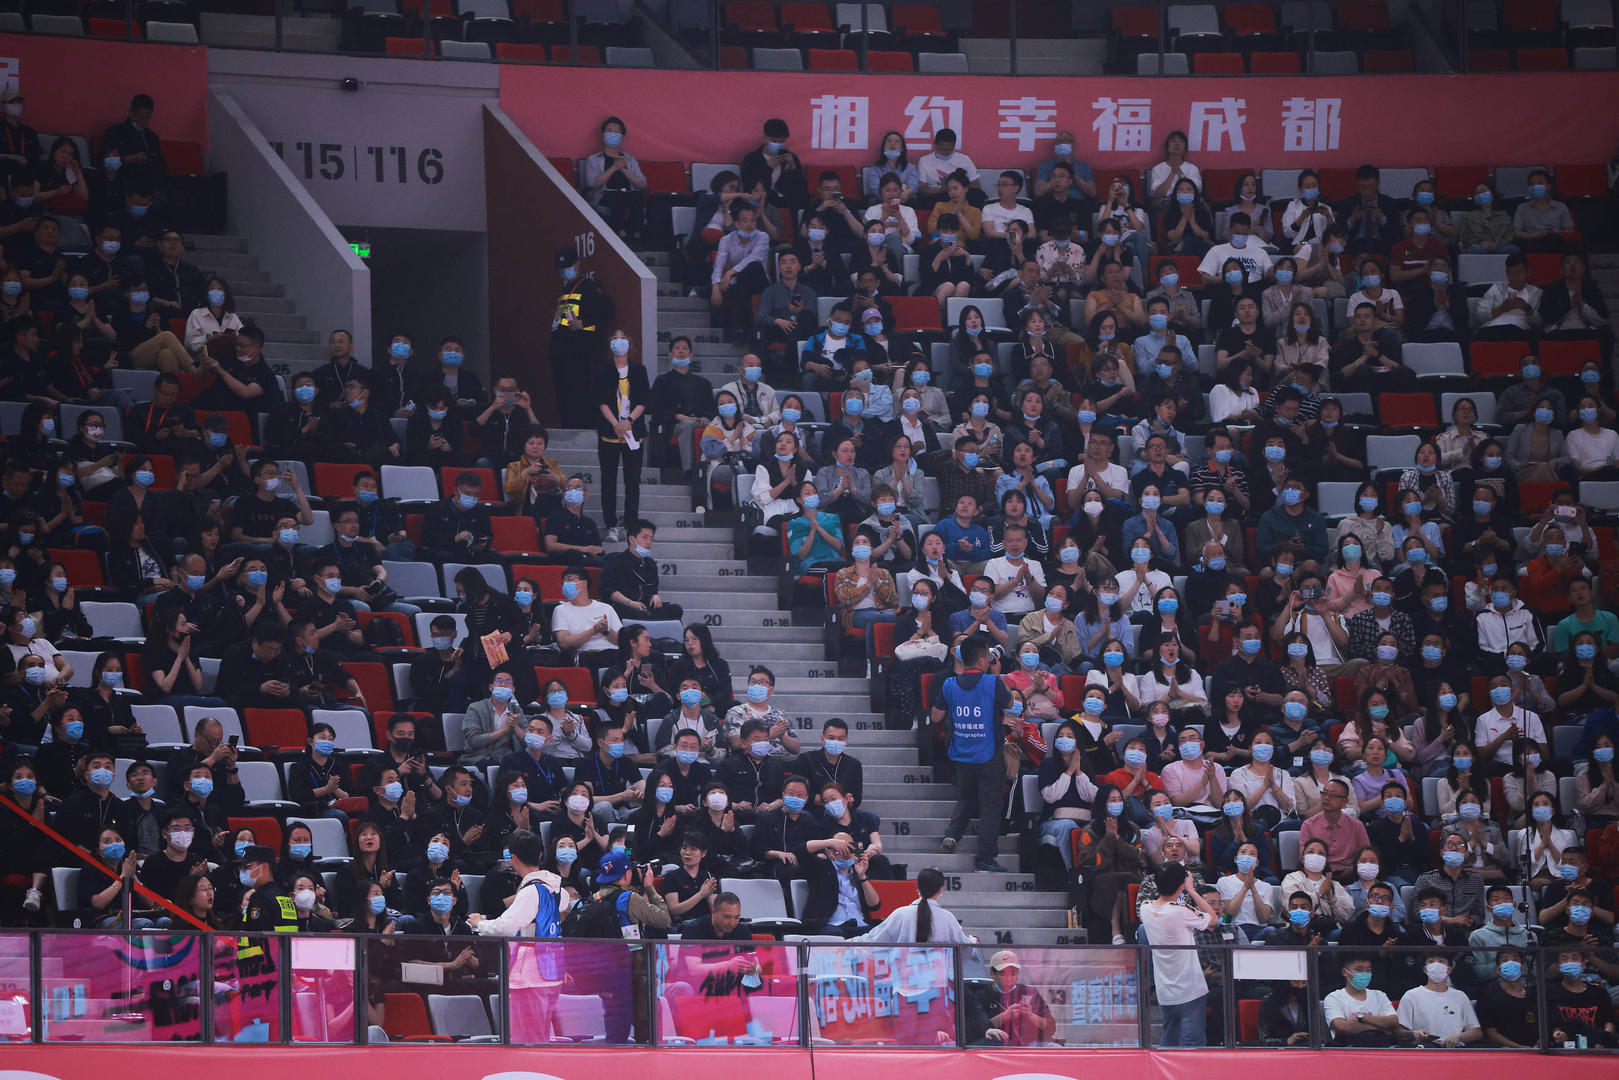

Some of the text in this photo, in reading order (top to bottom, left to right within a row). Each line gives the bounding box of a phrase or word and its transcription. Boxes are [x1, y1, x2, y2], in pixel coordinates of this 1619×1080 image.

[810, 94, 1342, 152] 相约幸福成都
[367, 146, 444, 185] 116
[574, 231, 595, 258] 116
[661, 563, 745, 576] 21 01-17
[703, 613, 722, 627] 20
[795, 717, 813, 730] 18
[892, 821, 910, 836] 16
[944, 876, 1034, 892] 15 01-09
[994, 930, 1013, 944] 14
